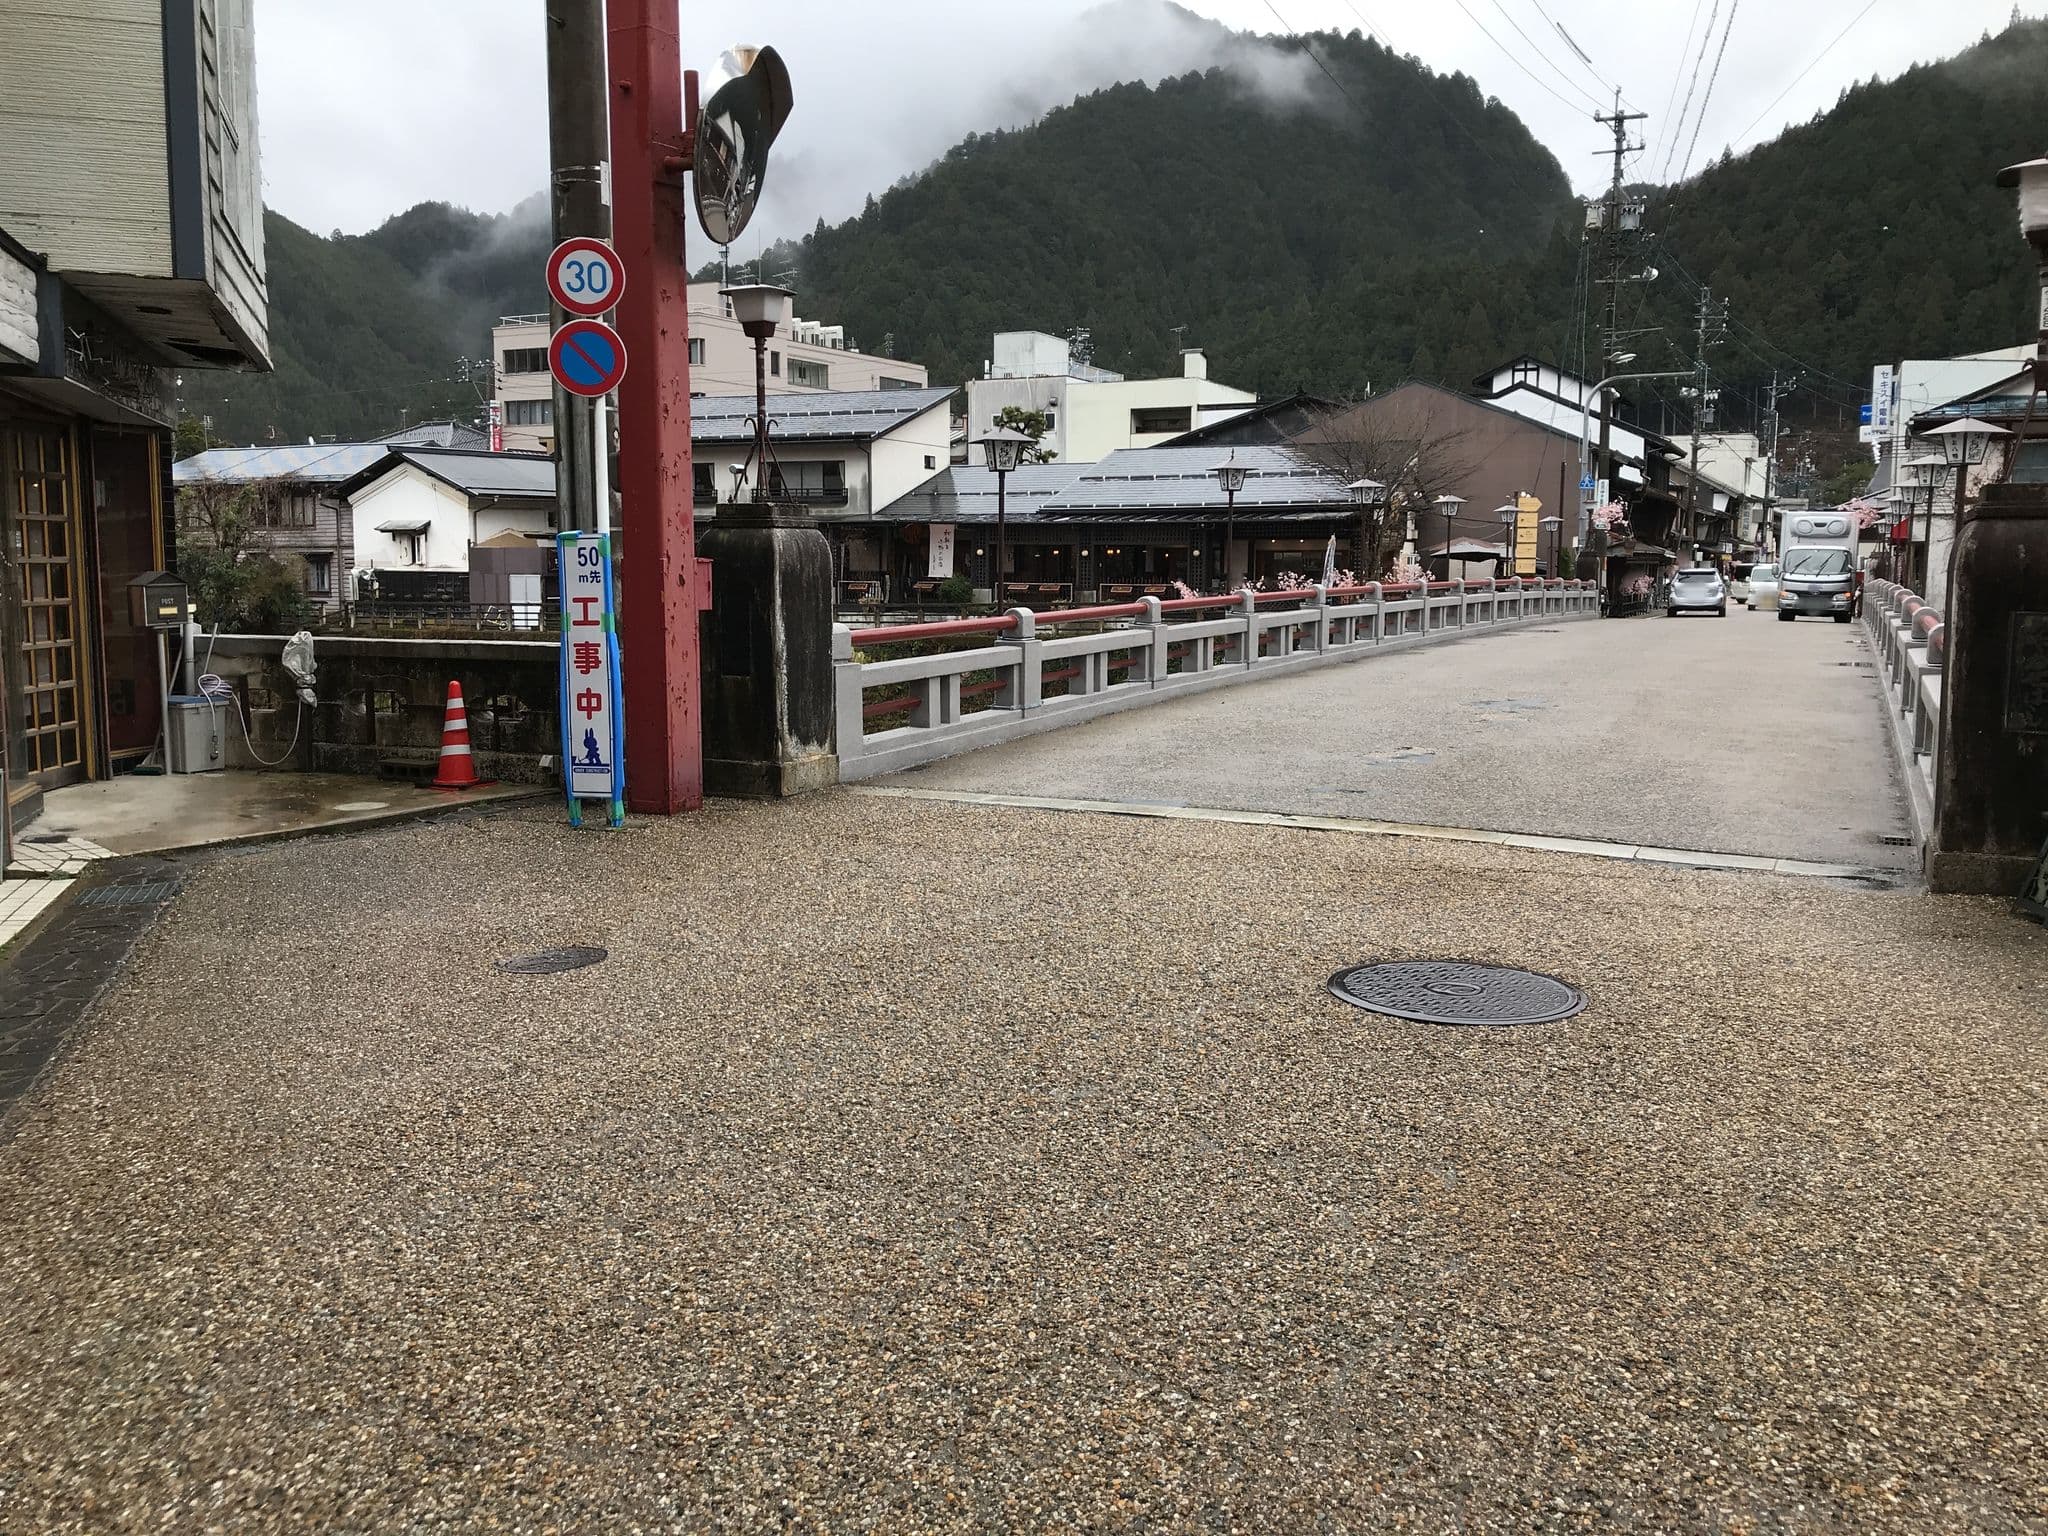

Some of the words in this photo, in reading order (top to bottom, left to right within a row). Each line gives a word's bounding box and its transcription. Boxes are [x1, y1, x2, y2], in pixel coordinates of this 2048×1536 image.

[566, 260, 607, 294] 30
[577, 546, 600, 567] 50
[578, 569, 601, 584] m先
[572, 597, 602, 720] 工事中
